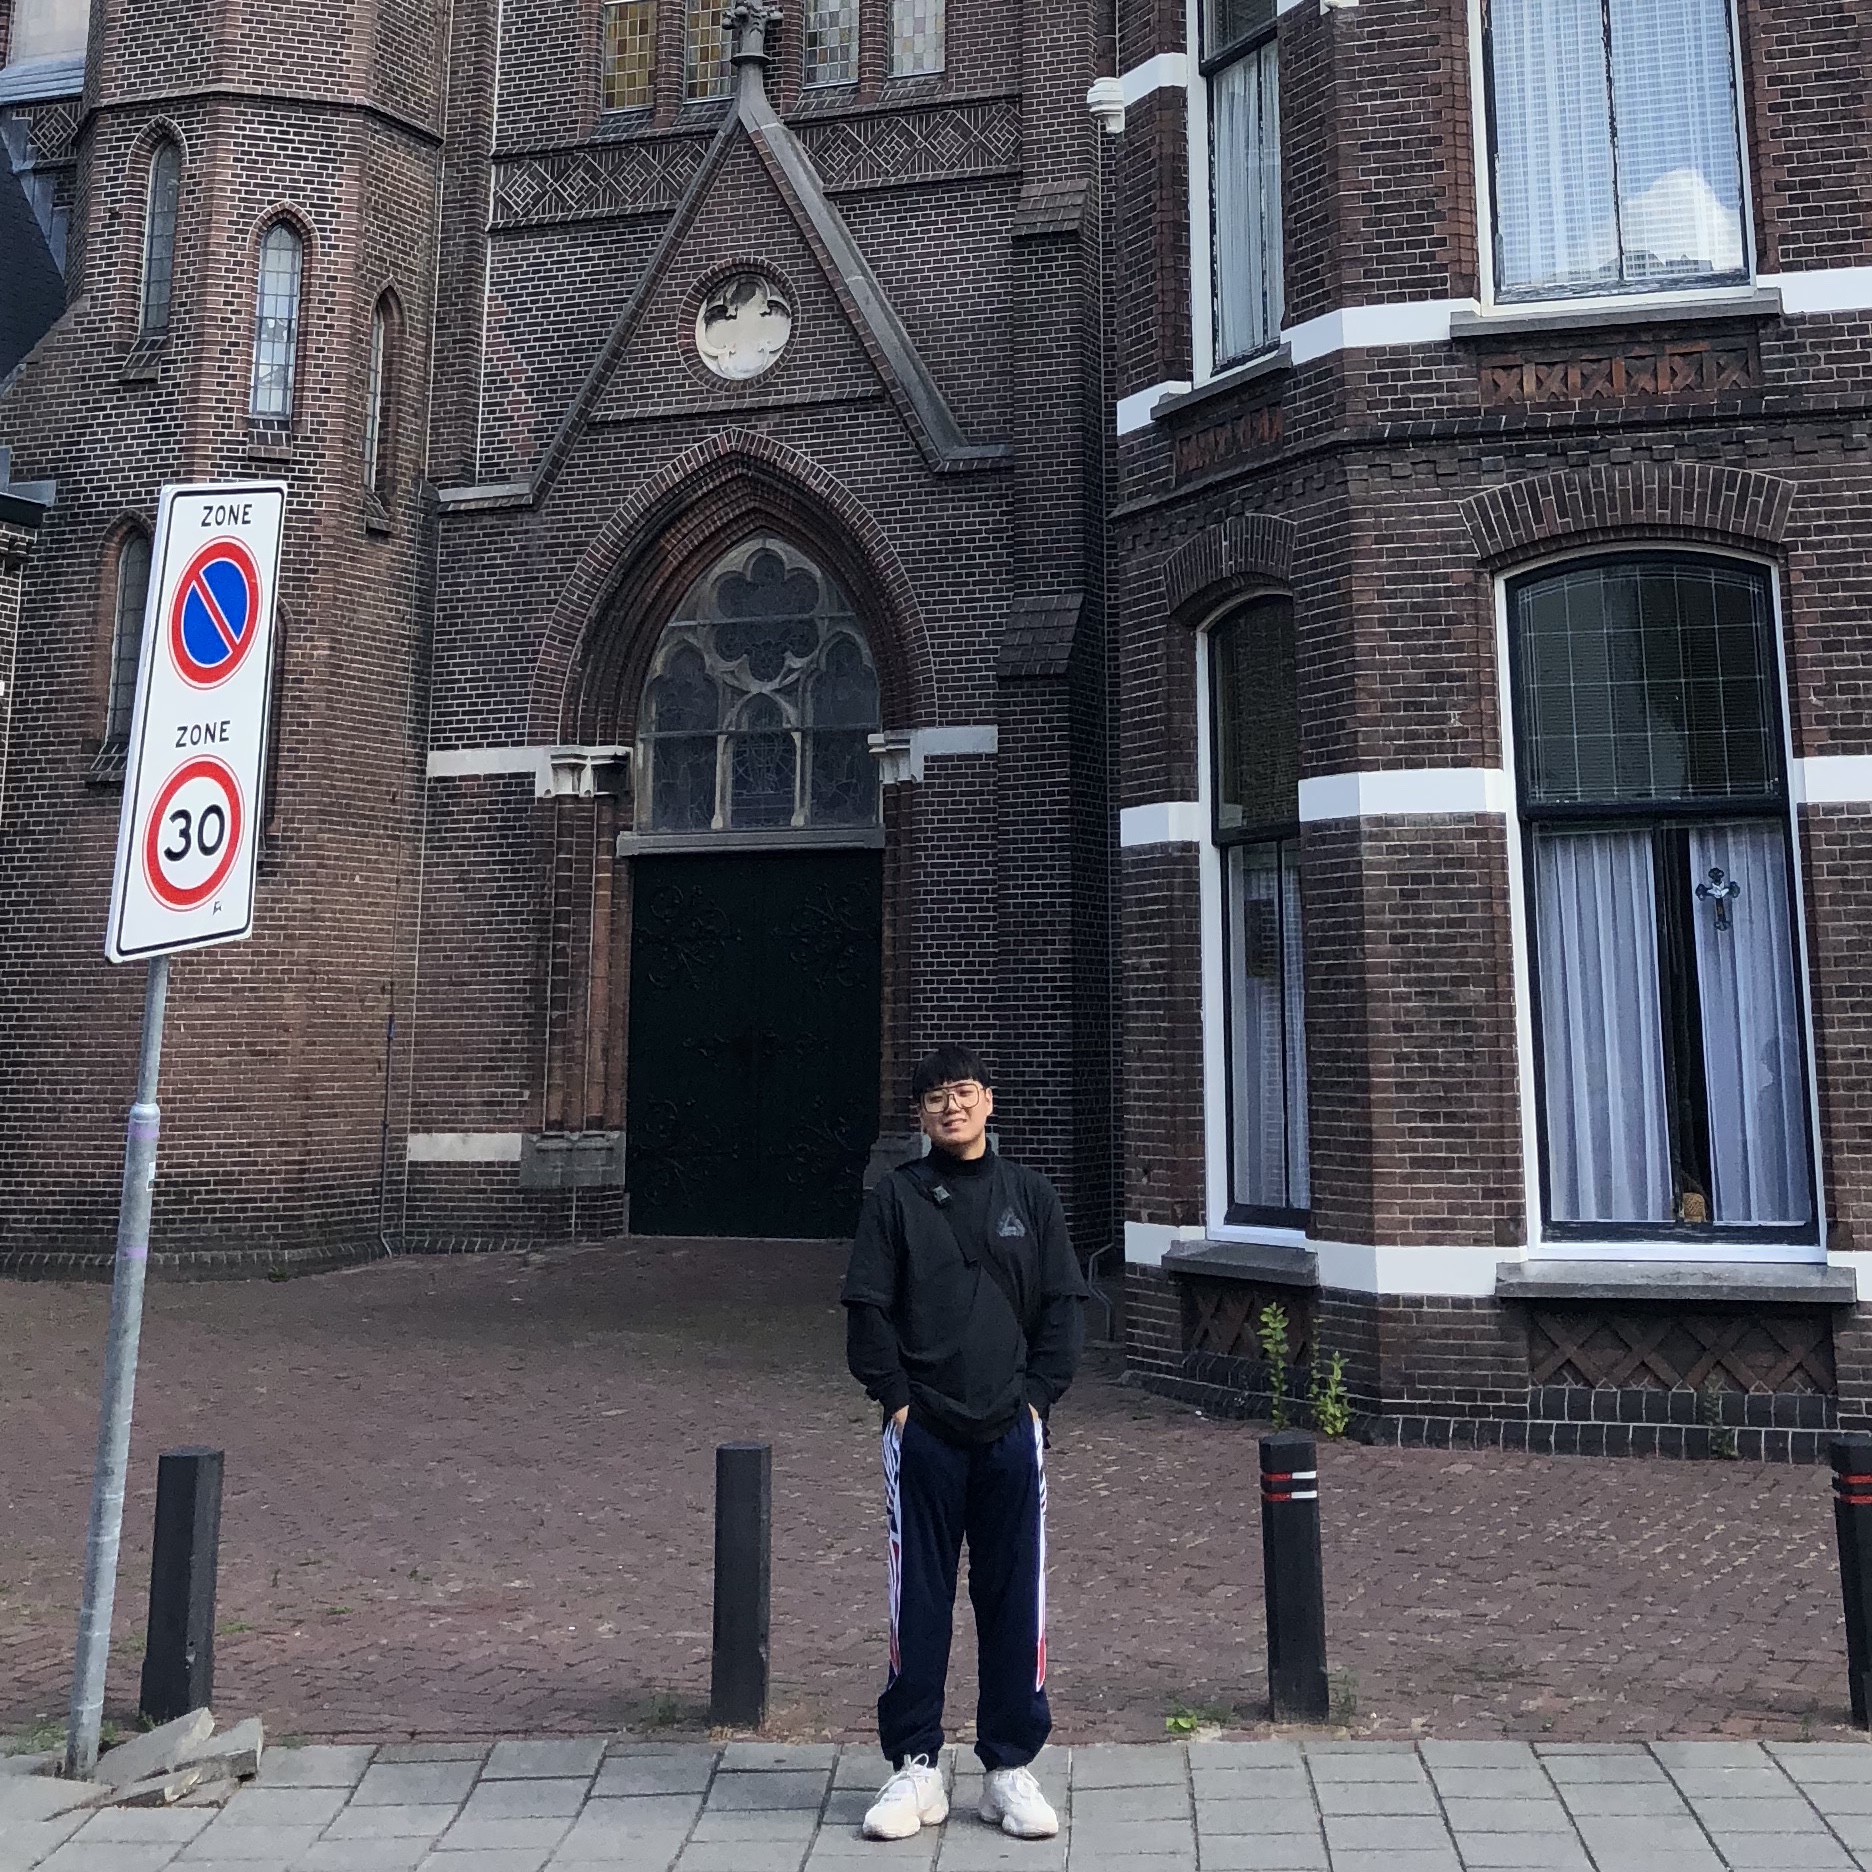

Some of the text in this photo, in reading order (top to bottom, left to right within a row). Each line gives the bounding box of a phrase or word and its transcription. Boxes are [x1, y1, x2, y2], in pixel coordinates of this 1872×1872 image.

[201, 504, 252, 527] ZONE
[175, 720, 231, 748] ZONE
[163, 804, 226, 862] 30
